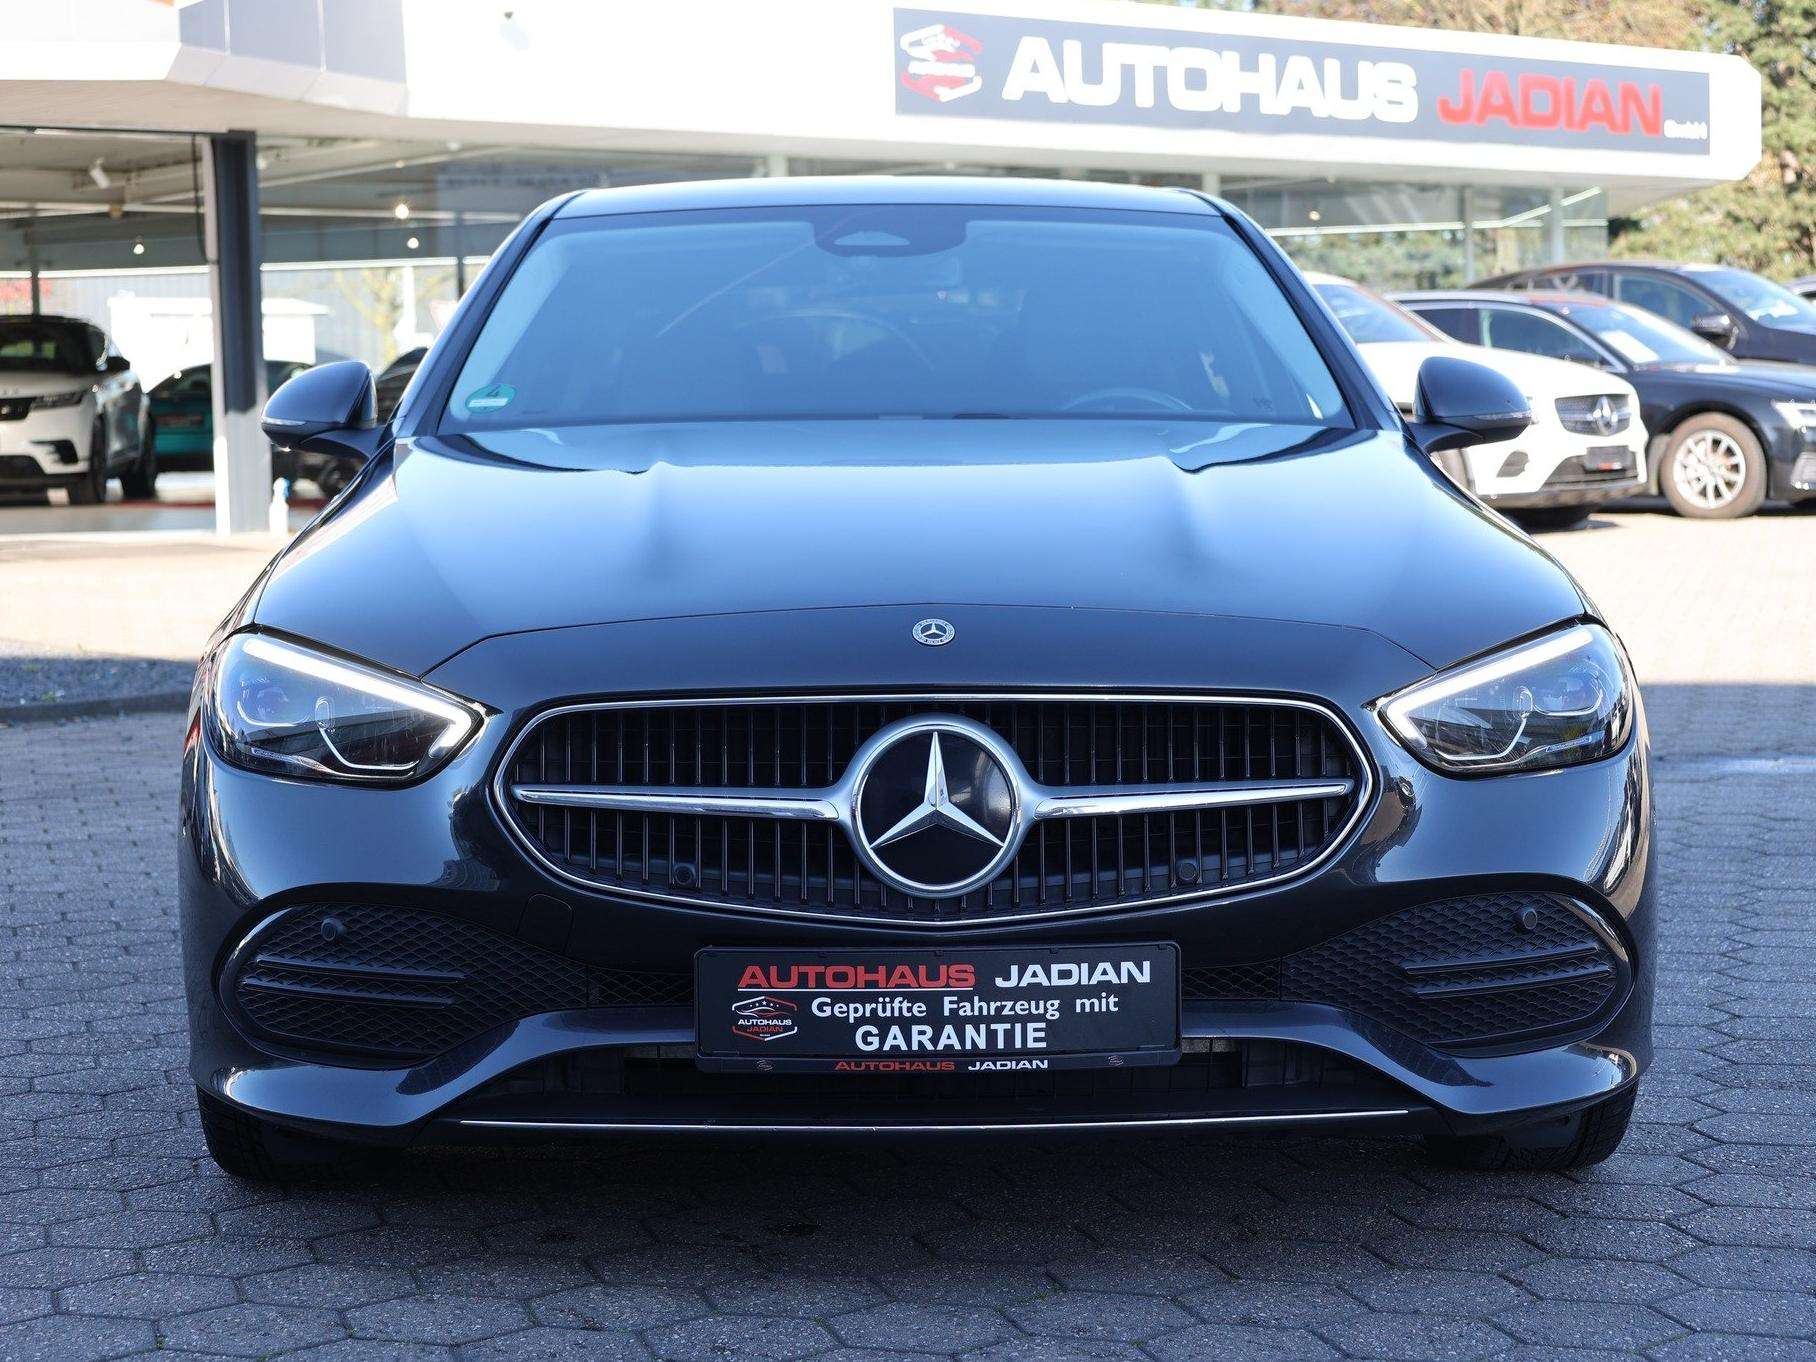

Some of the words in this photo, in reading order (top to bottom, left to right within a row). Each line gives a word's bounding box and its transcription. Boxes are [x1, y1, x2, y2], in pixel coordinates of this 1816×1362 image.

[1001, 36, 1418, 123] AUTOHAUS
[1436, 68, 1662, 137] JADIAN
[737, 964, 976, 989] AUTOHAUS
[994, 960, 1151, 988] JADIAN
[811, 996, 927, 1023] Geprüfte
[943, 996, 1060, 1020] Fahrzeug
[1075, 991, 1119, 1013] mit
[737, 1018, 792, 1026] AUTOHAUS
[746, 1025, 784, 1033] JADIAN
[855, 1022, 1047, 1051] GARANTIE
[833, 1060, 956, 1072] AUTOHAUS
[967, 1059, 1049, 1072] JADIAN
